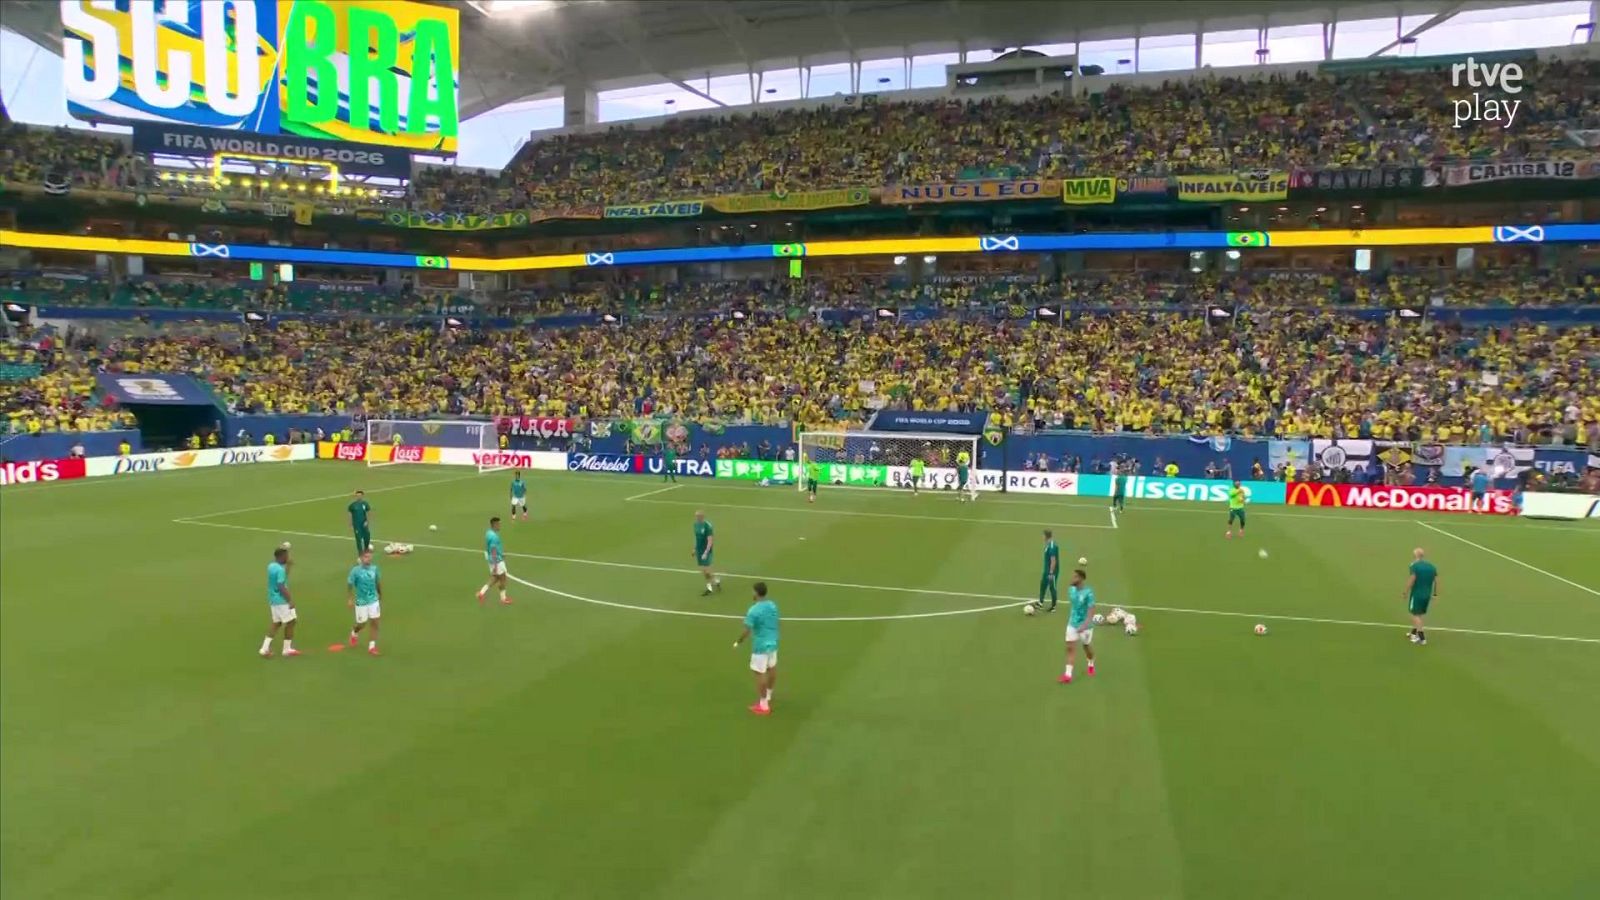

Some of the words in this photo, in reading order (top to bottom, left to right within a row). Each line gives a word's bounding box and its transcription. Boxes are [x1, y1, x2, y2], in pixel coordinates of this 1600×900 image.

[61, 0, 261, 117] SCO
[285, 2, 460, 137] BRA
[163, 132, 207, 150] FIFA
[209, 137, 280, 156] WORLD
[283, 145, 320, 160] CUP
[323, 148, 385, 166] 2026
[1469, 163, 1548, 180] CAMISA
[1554, 162, 1574, 176] 12
[1066, 179, 1112, 196] MVA
[114, 456, 165, 474] Dove
[220, 448, 264, 465] Dove
[472, 451, 531, 467] verizon
[569, 452, 630, 472] Michelob
[649, 458, 713, 475] UTRA
[893, 471, 938, 483] BAK
